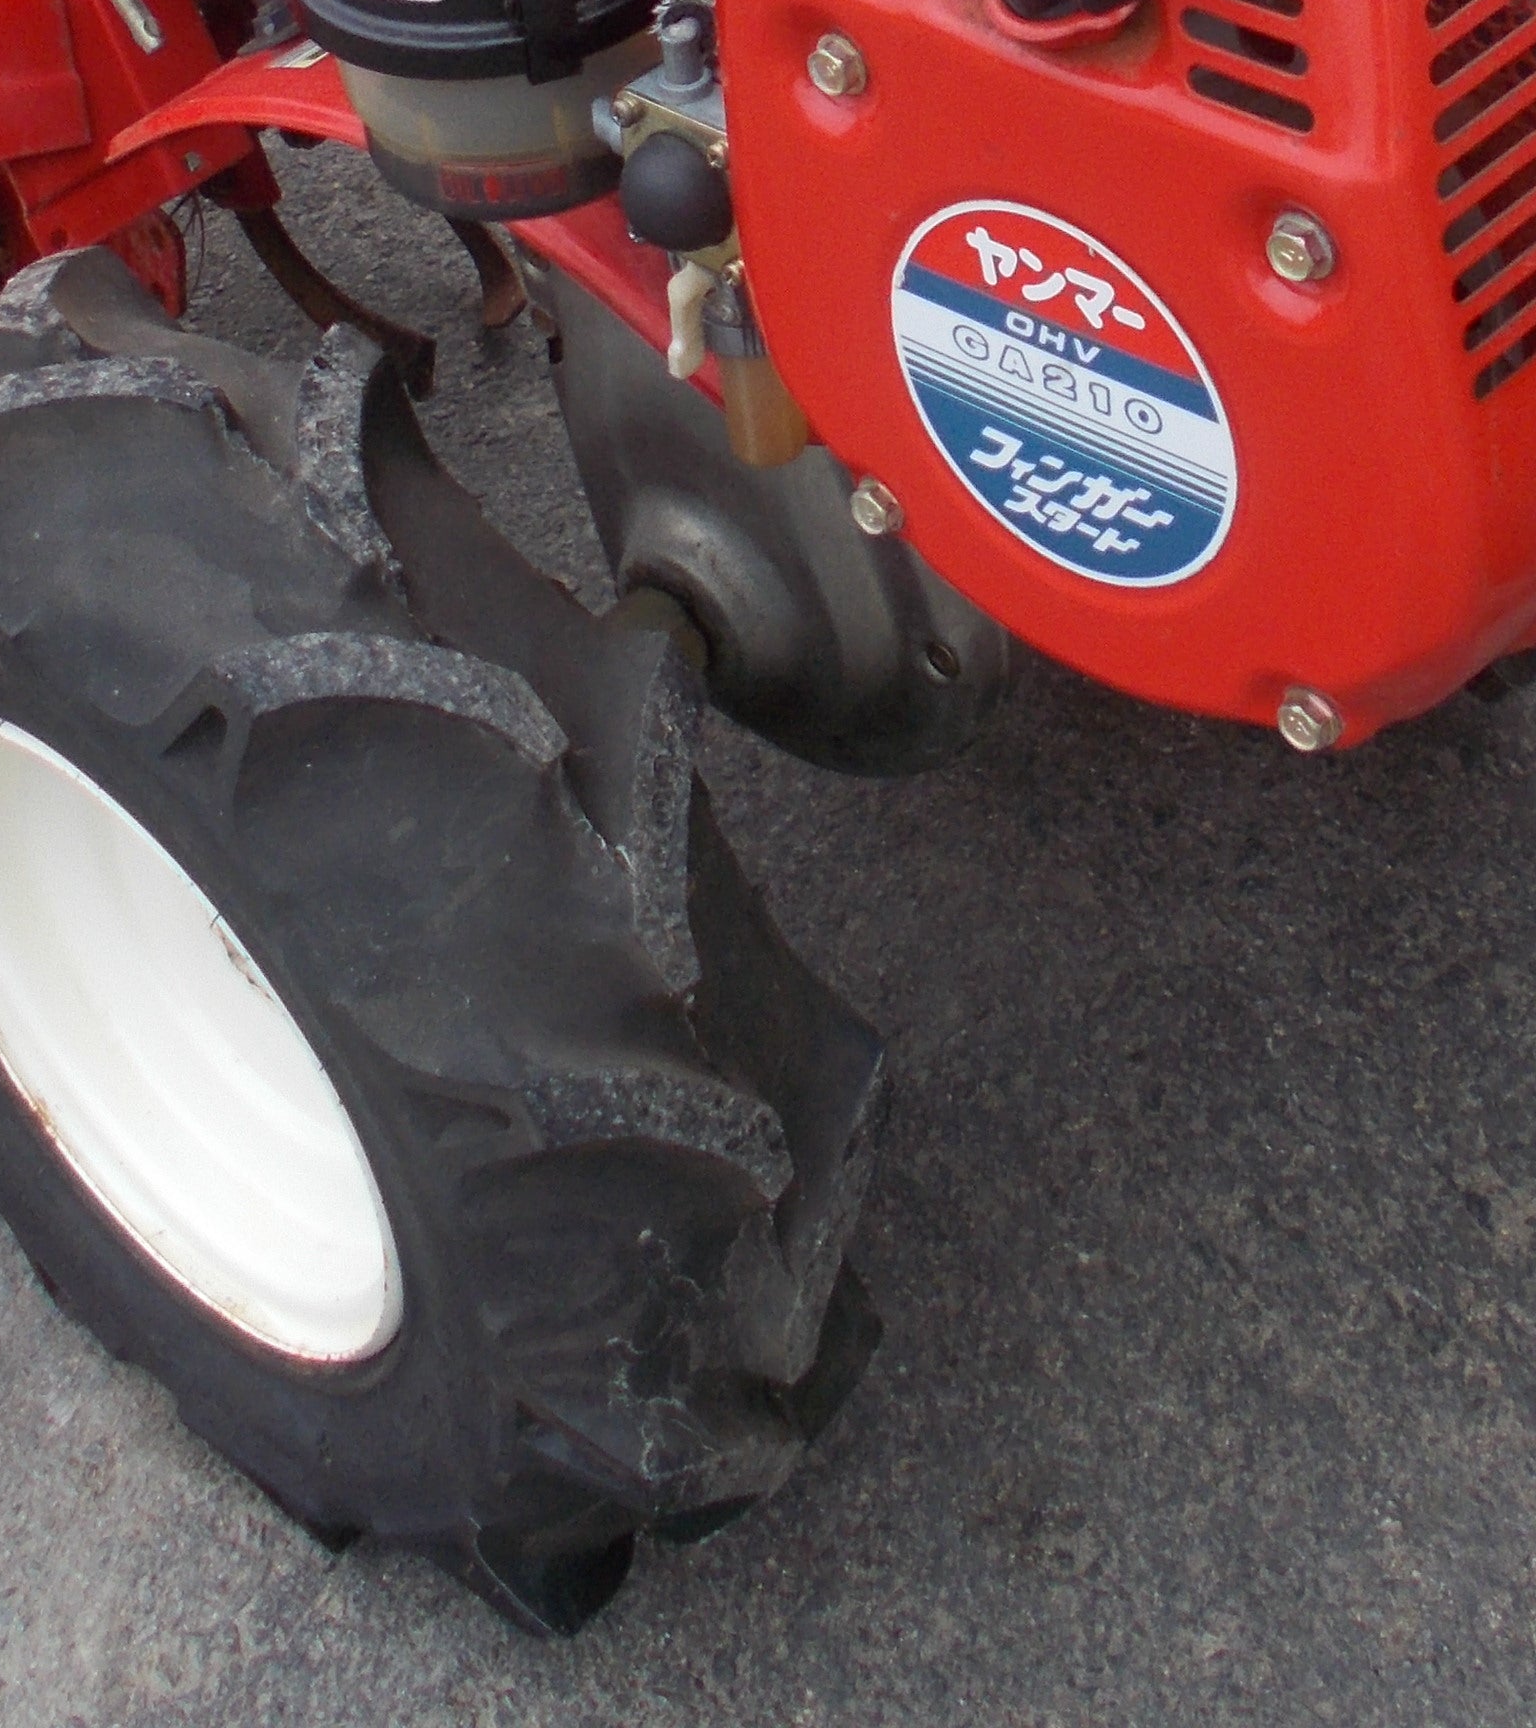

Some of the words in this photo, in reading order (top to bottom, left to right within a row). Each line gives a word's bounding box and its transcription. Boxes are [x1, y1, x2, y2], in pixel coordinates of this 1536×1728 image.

[966, 226, 1146, 331] ヤンマー
[952, 324, 1163, 435] GA210
[1006, 311, 1101, 364] OHV
[969, 425, 1175, 528] フィンガー
[1003, 484, 1141, 553] スタート
